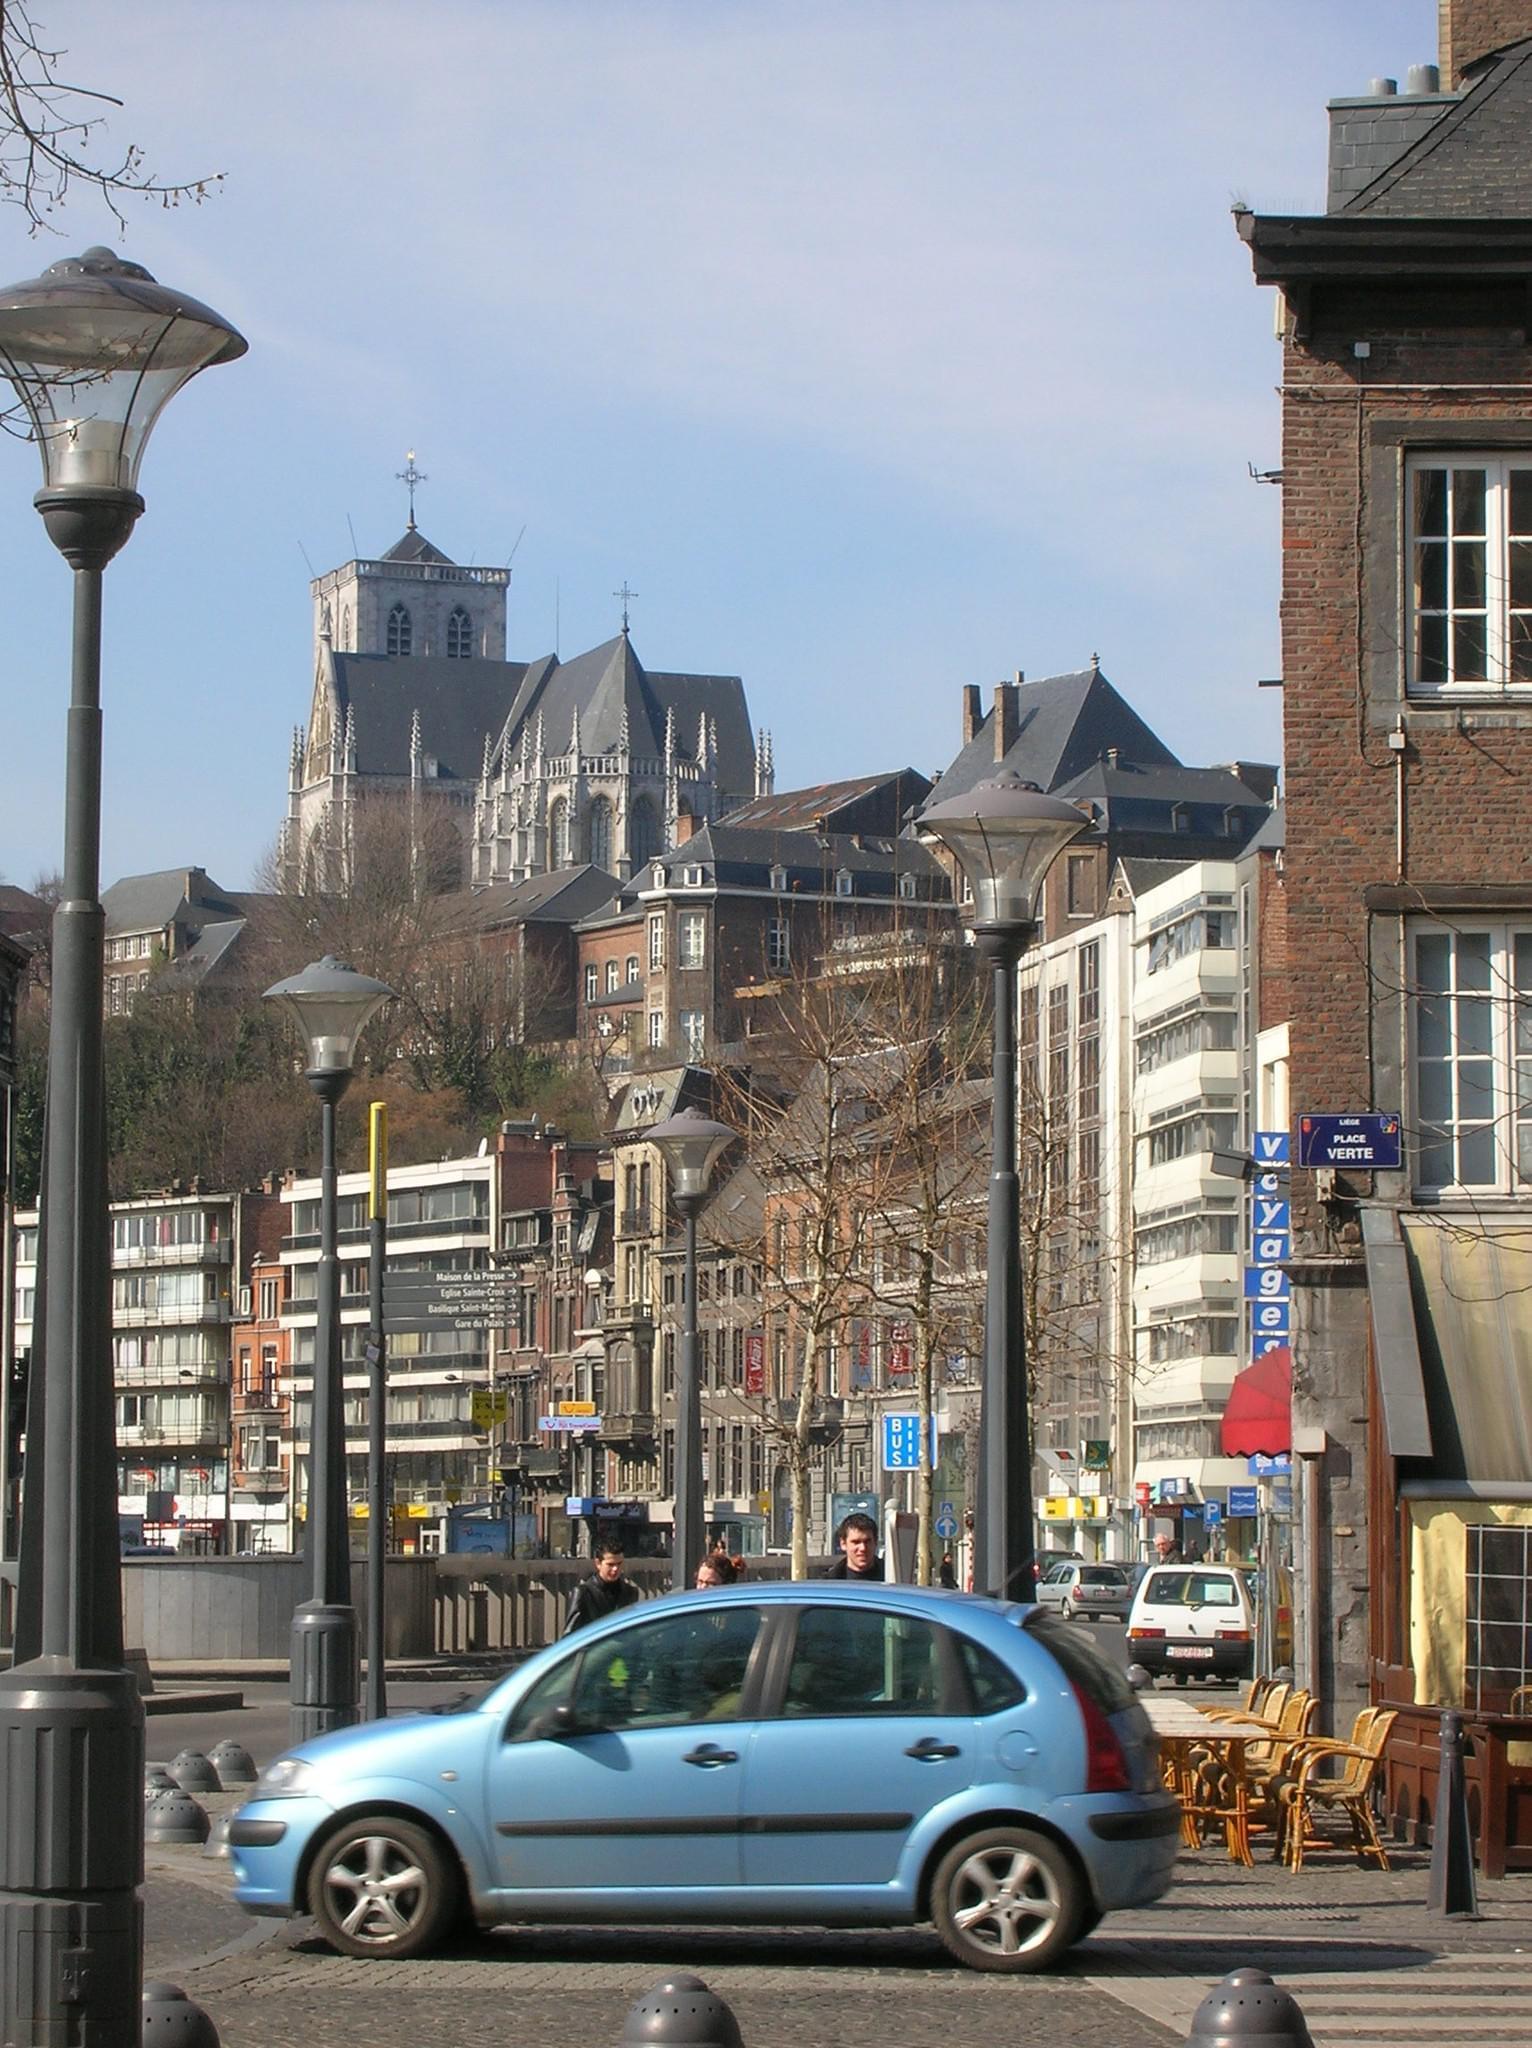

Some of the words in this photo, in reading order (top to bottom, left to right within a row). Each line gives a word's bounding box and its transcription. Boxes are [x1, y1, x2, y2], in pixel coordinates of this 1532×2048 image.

[1333, 1134, 1366, 1143] PLACE
[1327, 1147, 1374, 1160] VERTE
[436, 1273, 462, 1281] Maison
[463, 1272, 472, 1281] de
[473, 1272, 481, 1280] la
[482, 1272, 505, 1280] Presse
[462, 1288, 505, 1297] Sainte-Croix
[428, 1304, 460, 1315] Basilique
[460, 1303, 505, 1313] Saint-Martin
[455, 1320, 472, 1328] Gare
[472, 1320, 482, 1328] du
[483, 1319, 505, 1328] Palais
[892, 1418, 902, 1466] BUS
[1207, 1503, 1218, 1520] P
